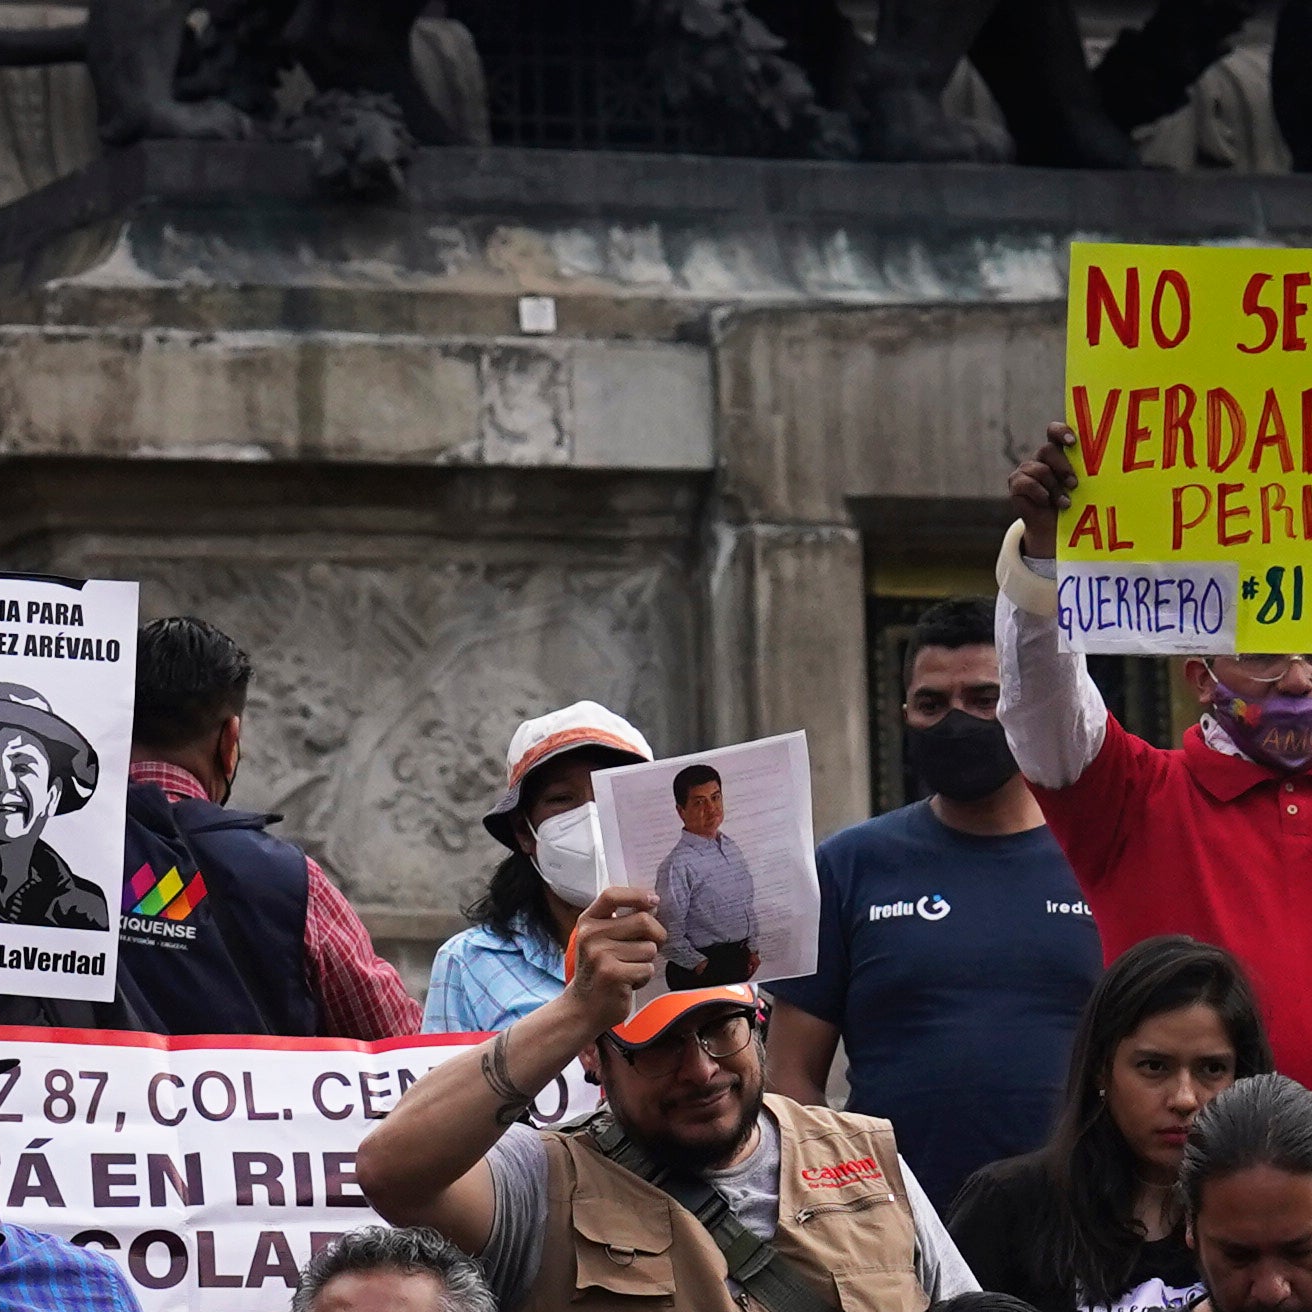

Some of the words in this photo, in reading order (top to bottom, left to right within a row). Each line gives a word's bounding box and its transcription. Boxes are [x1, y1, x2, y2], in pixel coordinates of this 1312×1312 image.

[1085, 265, 1191, 350] NO
[1236, 271, 1312, 355] SE
[1068, 503, 1135, 552] AL
[26, 601, 85, 628] PARA
[1057, 573, 1224, 641] GUERRERO
[1241, 564, 1304, 625] #81
[23, 629, 121, 662] ARÉVALO
[43, 1067, 126, 1135] 87,
[148, 1071, 294, 1124] COL.
[90, 1152, 207, 1208] EN
[232, 1151, 372, 1208] RIE
